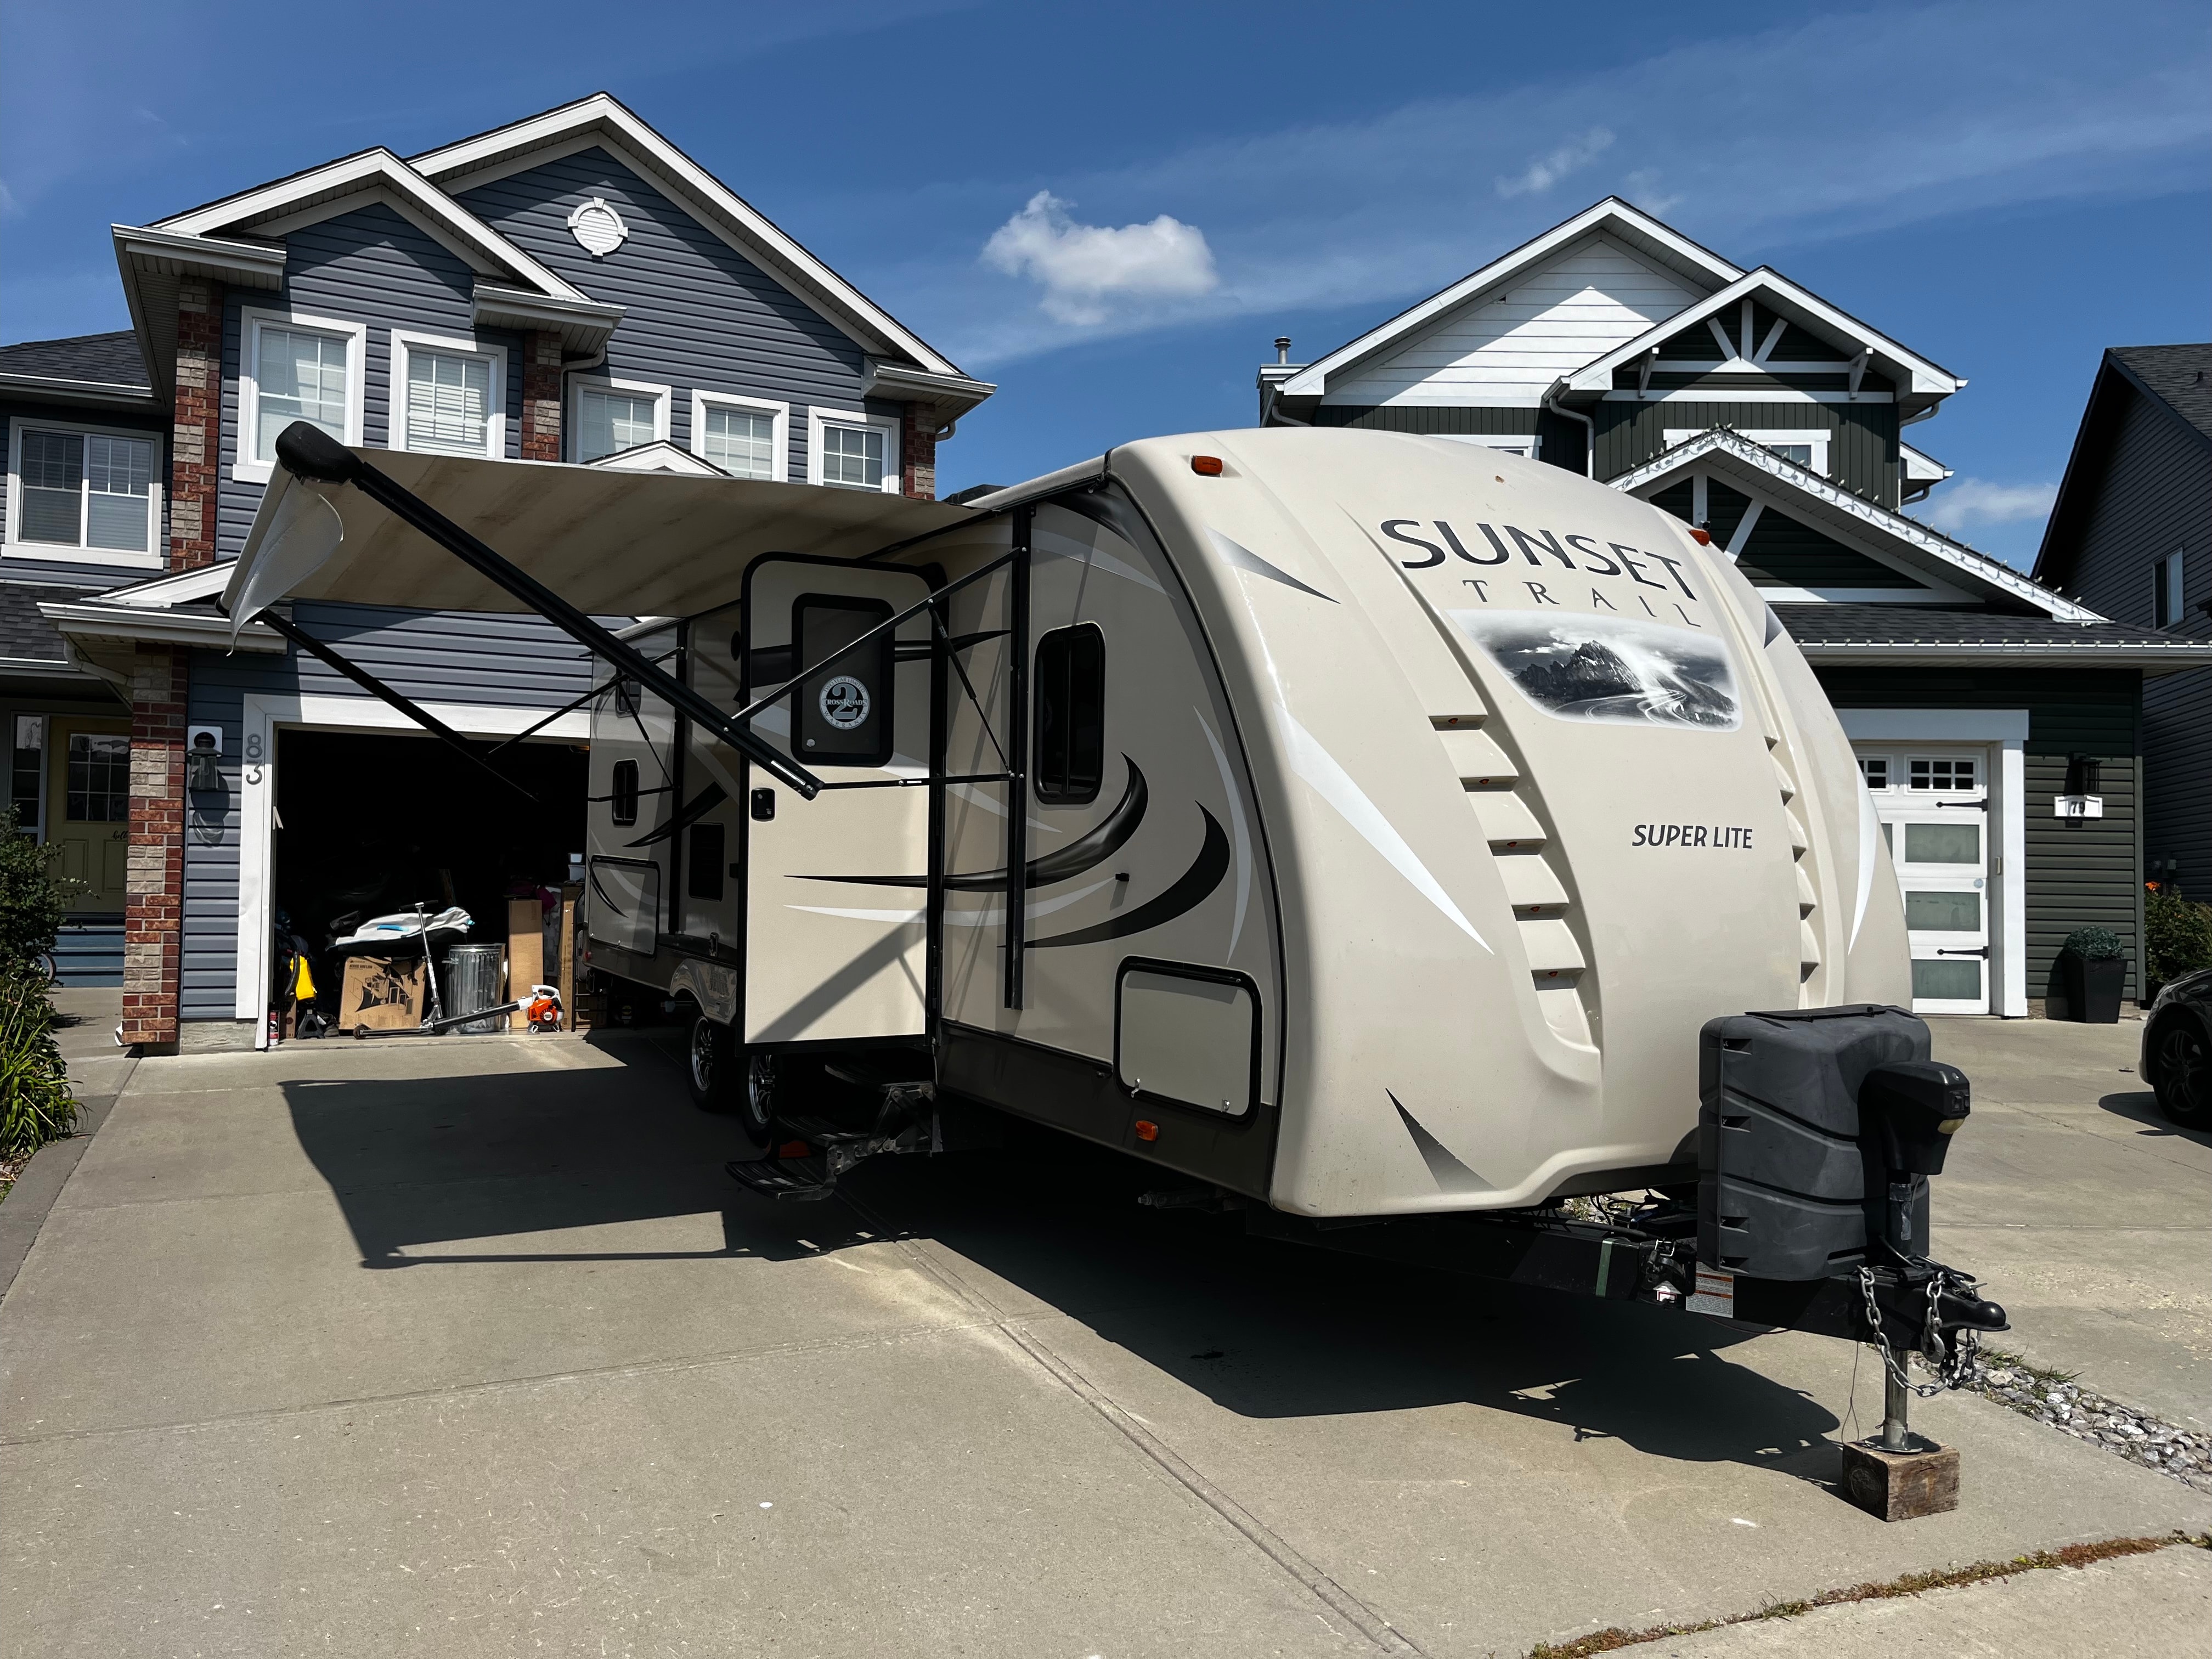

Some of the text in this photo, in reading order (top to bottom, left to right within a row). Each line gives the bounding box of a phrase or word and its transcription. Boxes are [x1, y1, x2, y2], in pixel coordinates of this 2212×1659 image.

[1380, 520, 1697, 601] SUNSET
[1462, 580, 1701, 627] TRAIL
[824, 681, 834, 692] TWO
[848, 678, 865, 693] LIMITED
[832, 683, 857, 719] 2
[824, 711, 867, 727] WARRANTY
[246, 733, 263, 785] 83
[2071, 801, 2085, 814] 79
[111, 830, 129, 840] hell
[1632, 825, 1753, 849] SUPER LITE
